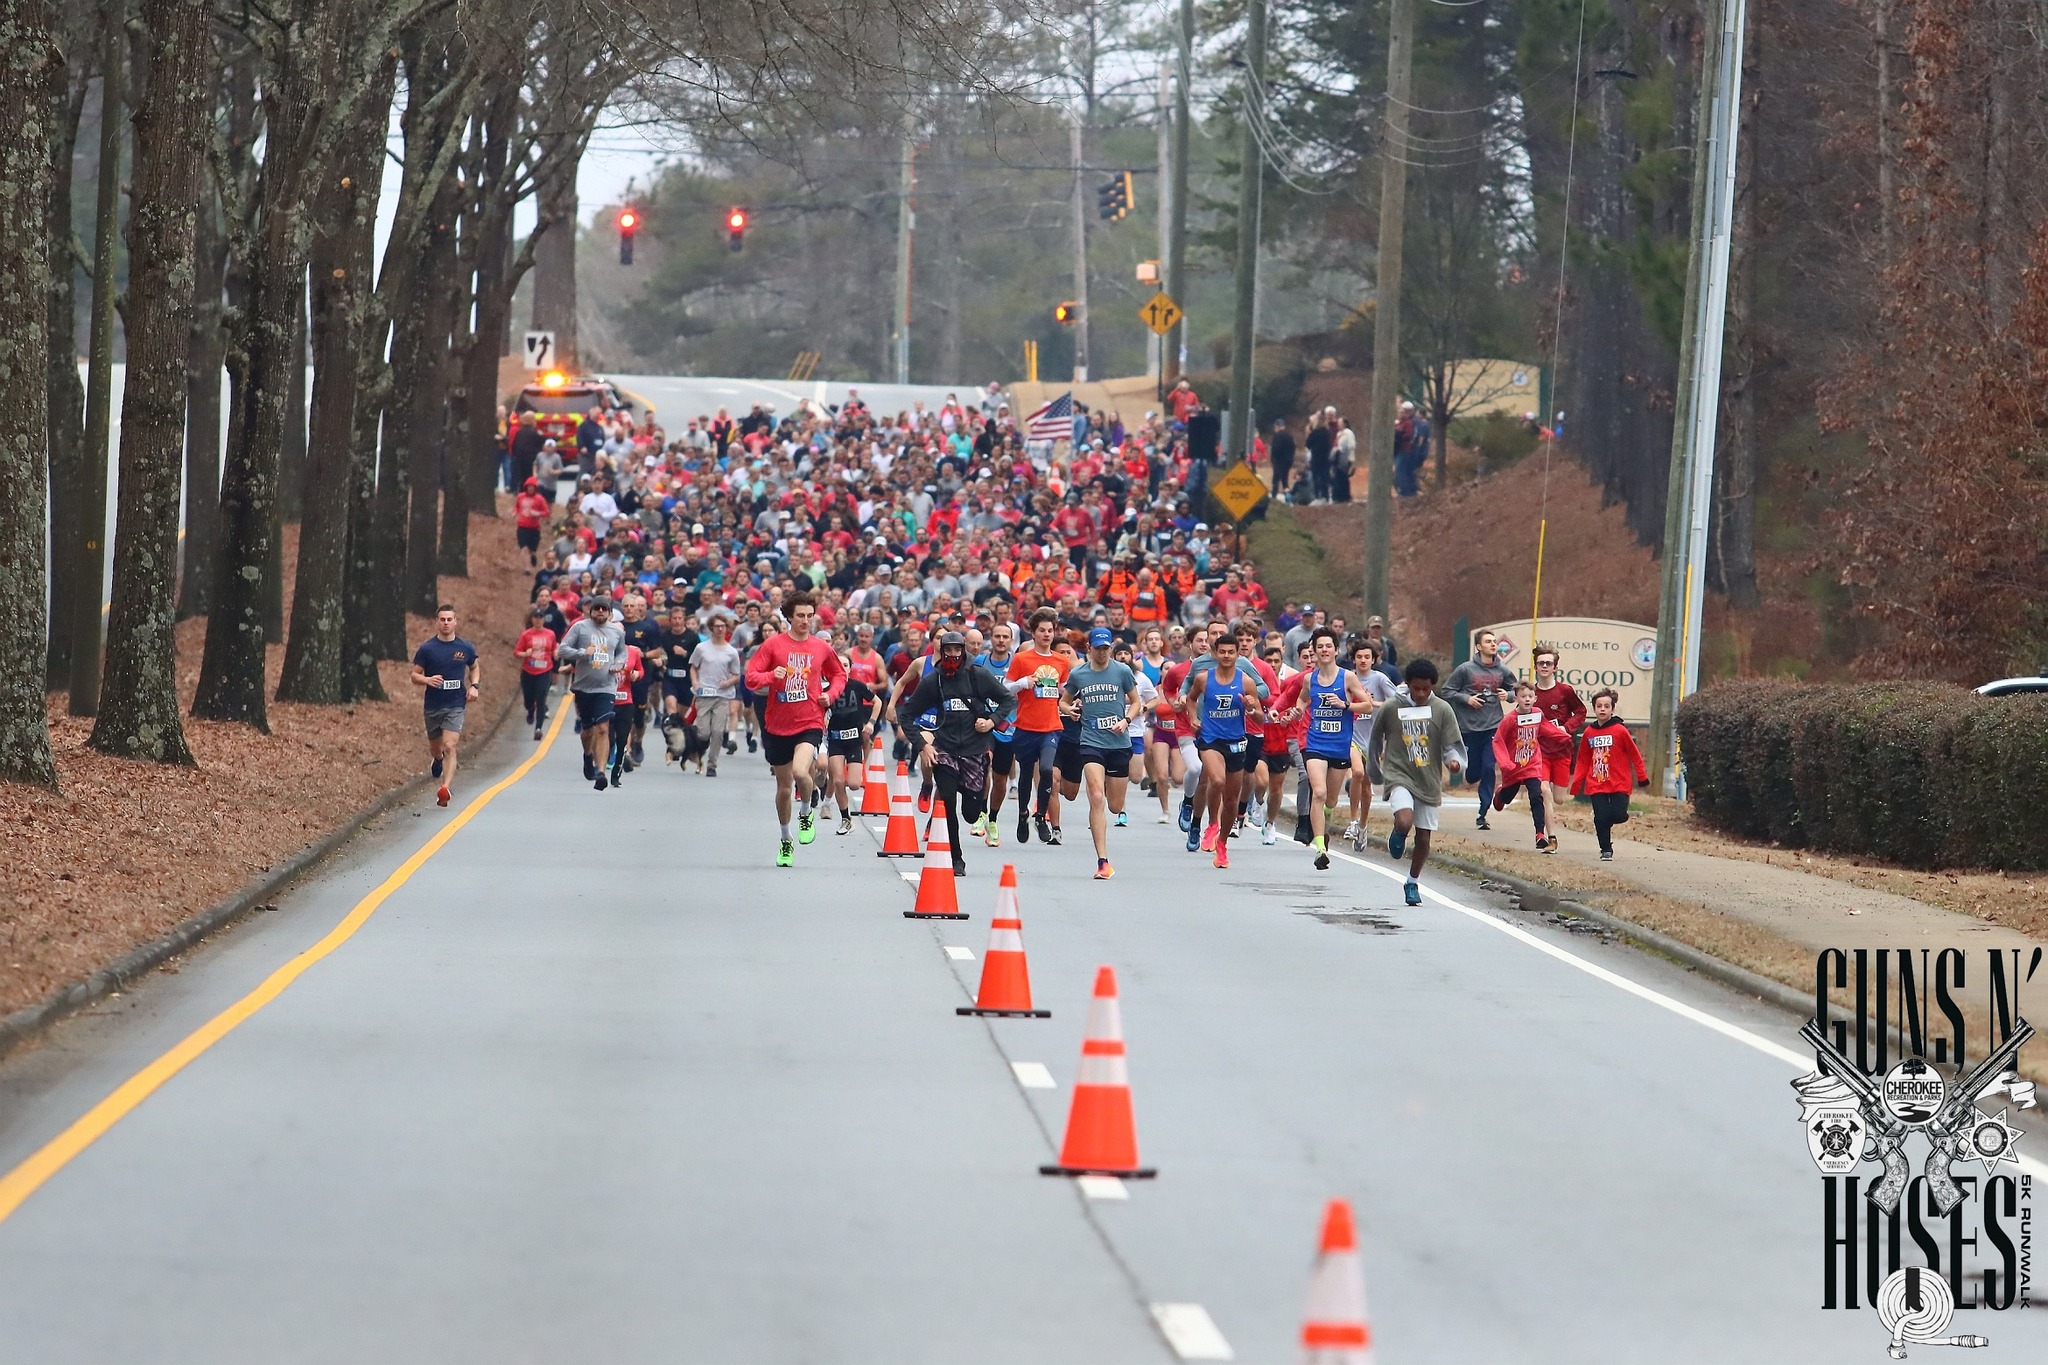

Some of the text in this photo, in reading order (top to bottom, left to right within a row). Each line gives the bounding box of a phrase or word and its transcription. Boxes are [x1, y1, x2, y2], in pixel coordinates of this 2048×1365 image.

[1518, 668, 1634, 687] HBGOOD
[1081, 683, 1119, 697] CREEKVIEW
[788, 691, 806, 701] 2943
[1085, 693, 1117, 703] DISTANCE
[1099, 716, 1116, 728] 1375
[1322, 721, 1340, 731] 3019
[841, 730, 857, 739] 2972
[1595, 737, 1611, 746] 2572
